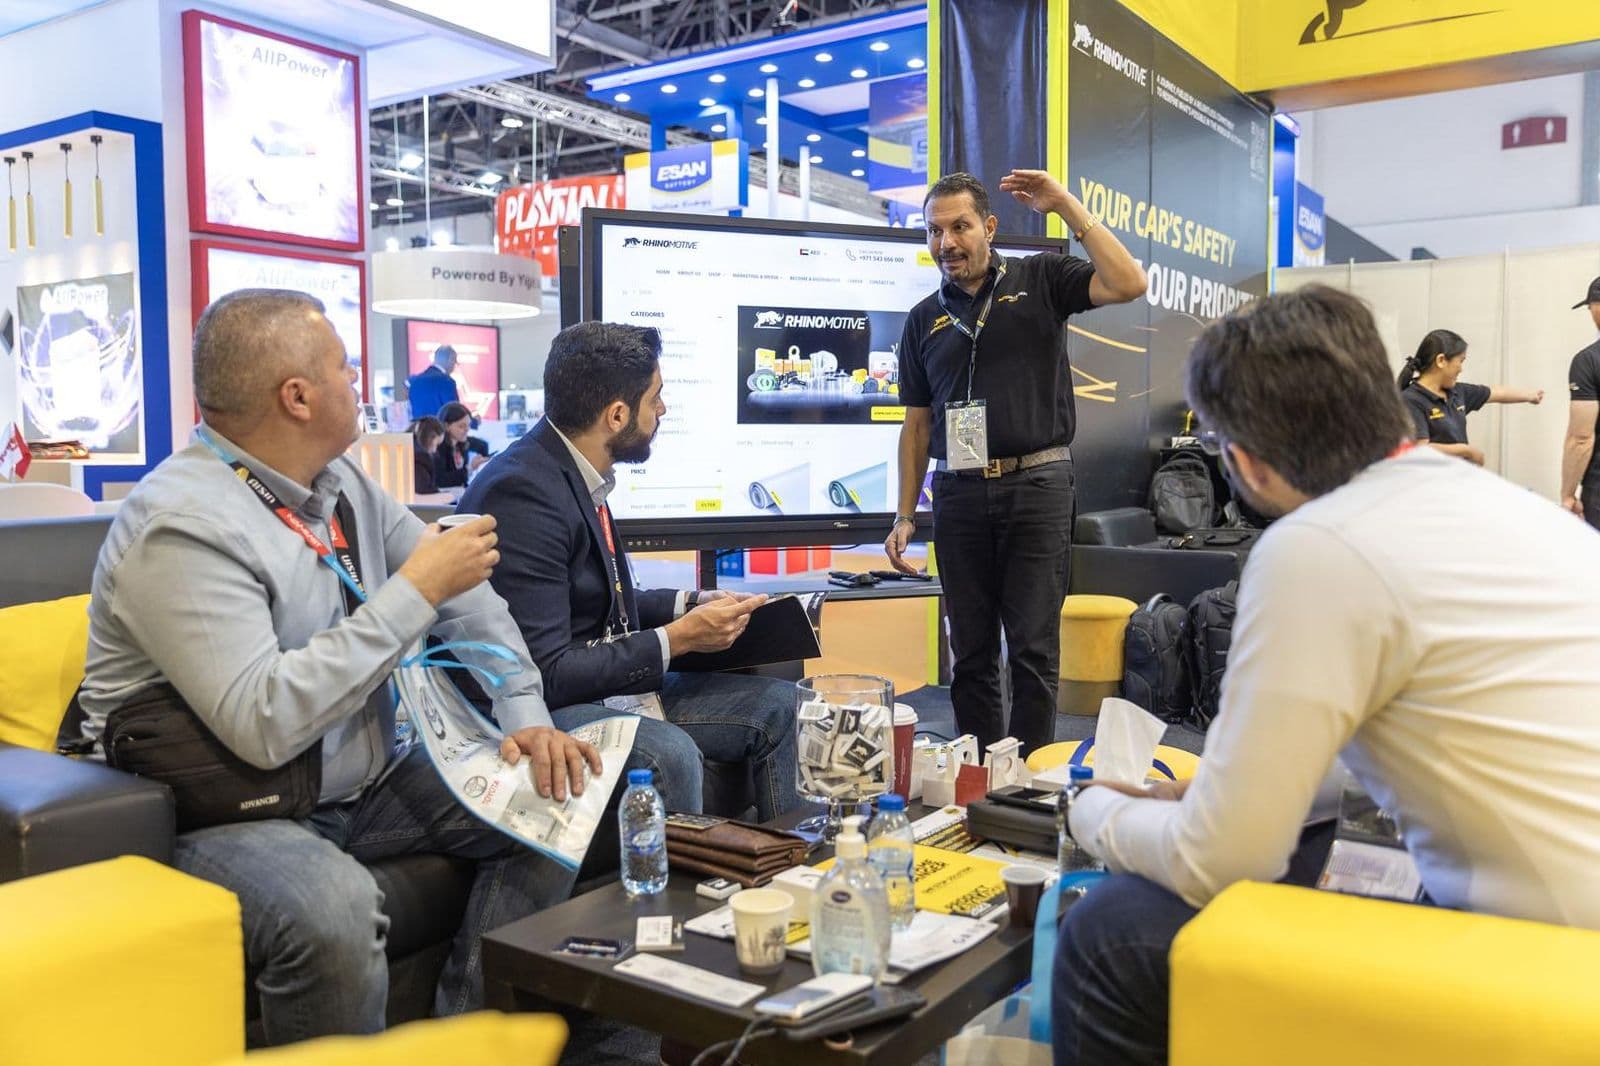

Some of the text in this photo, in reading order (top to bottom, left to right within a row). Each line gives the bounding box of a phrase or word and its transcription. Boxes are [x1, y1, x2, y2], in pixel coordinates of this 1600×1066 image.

[252, 47, 328, 79] AllPower
[1093, 38, 1147, 87] RHINOMOTIVE
[656, 161, 707, 182] ESAN
[1079, 176, 1237, 268] YOUR CAR'S SAFETY
[642, 239, 698, 250] RHINOMOTIVE
[431, 266, 495, 282] Powered
[499, 271, 515, 287] By
[1146, 262, 1261, 320] OUR PRIOR
[630, 310, 665, 318] CATEGORIES
[785, 315, 866, 330] RHINOMOTIVE
